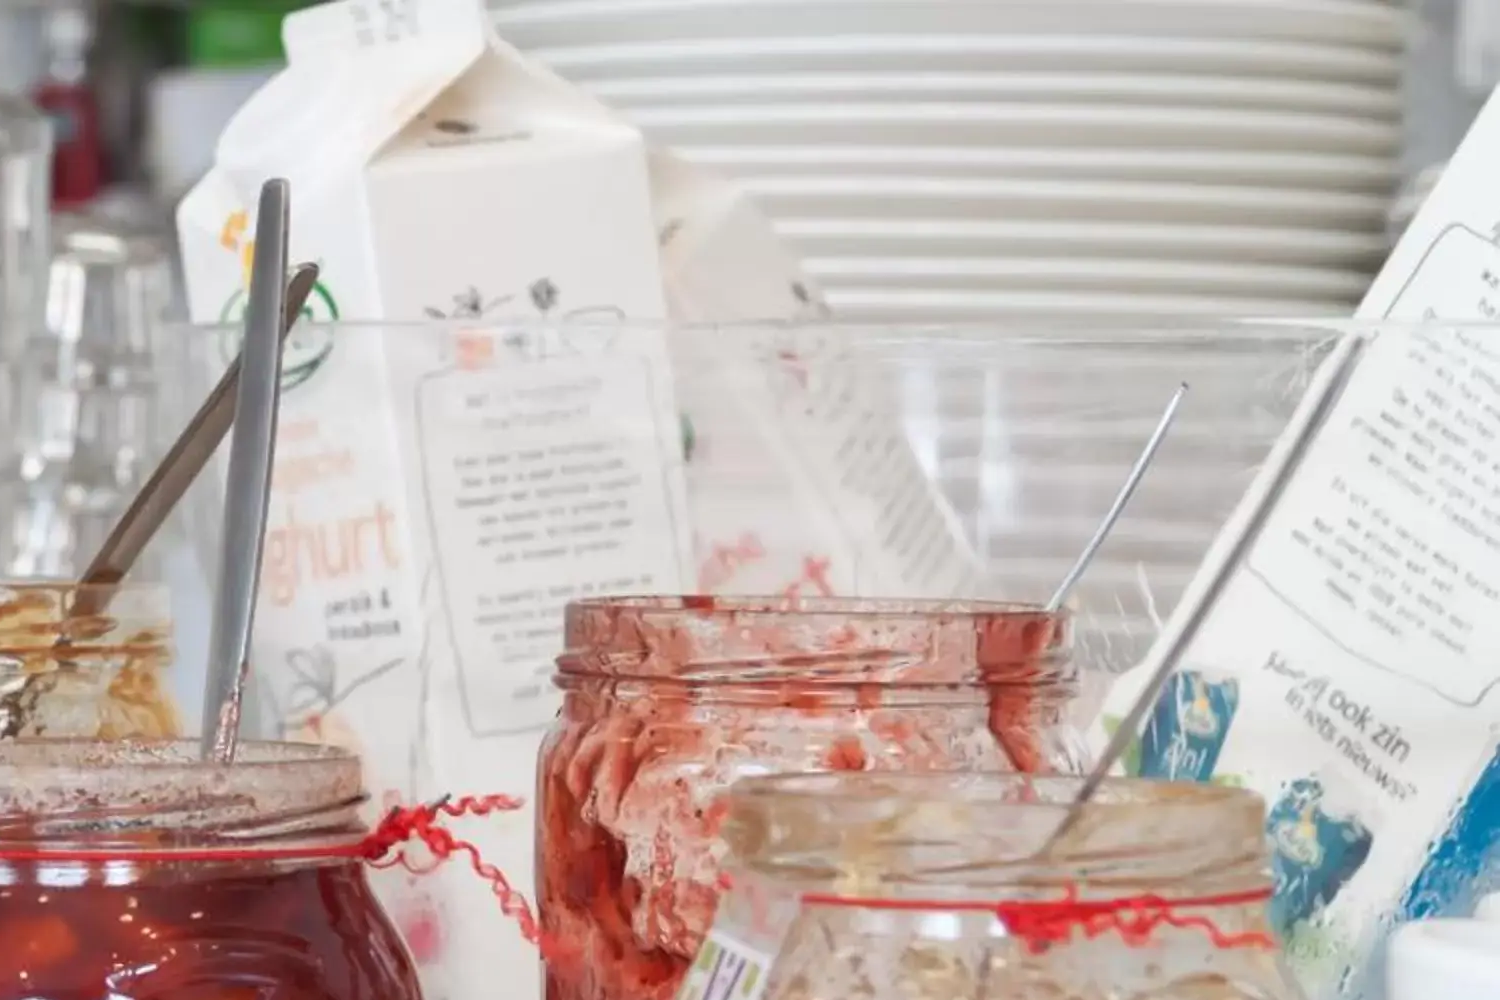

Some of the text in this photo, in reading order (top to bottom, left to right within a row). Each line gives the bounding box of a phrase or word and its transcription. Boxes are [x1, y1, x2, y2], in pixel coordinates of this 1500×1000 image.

[264, 502, 402, 607] ghurt
[1328, 688, 1374, 734] ook
[1370, 722, 1412, 765] zin
